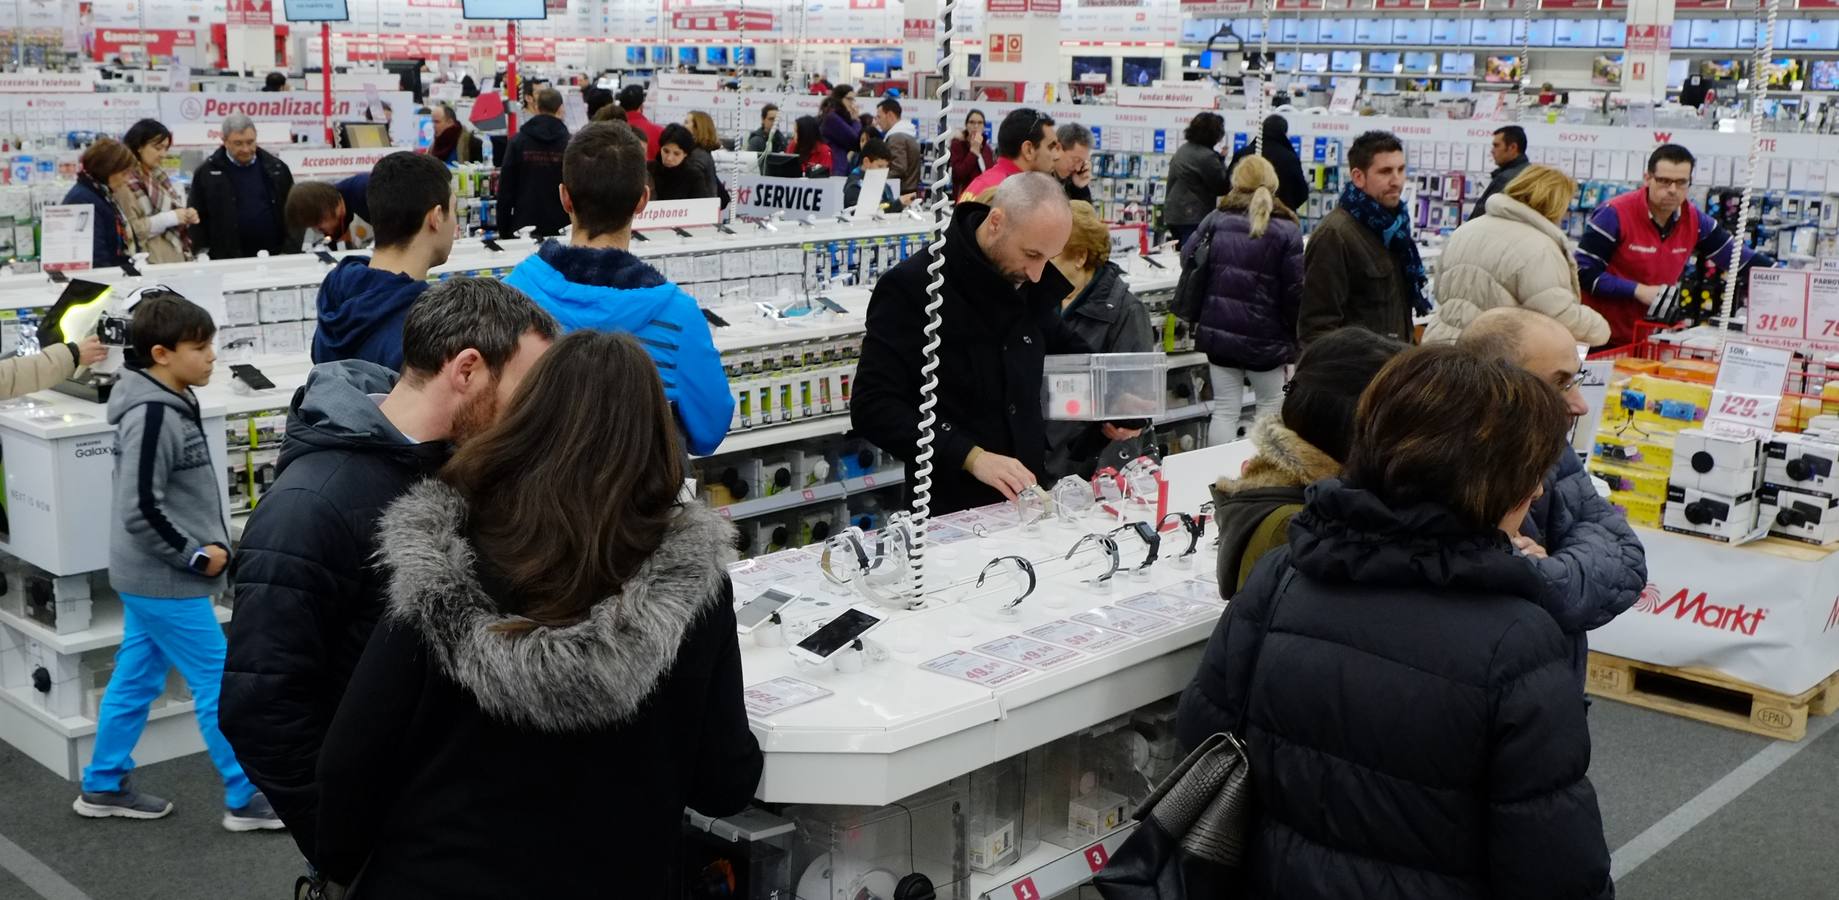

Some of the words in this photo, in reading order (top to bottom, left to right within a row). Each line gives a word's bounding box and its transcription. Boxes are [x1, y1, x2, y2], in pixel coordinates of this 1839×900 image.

[1138, 93, 1164, 102] Fundas
[1050, 110, 1082, 120] SAMSUNG
[1115, 113, 1147, 123] SAMSUNG
[1312, 121, 1350, 131] SAMSUNG
[1392, 126, 1432, 135] SAMSUNG
[1558, 132, 1599, 142] SONY
[302, 157, 353, 168] Accesorios
[754, 184, 823, 212] SERVICE
[1753, 273, 1780, 282] GIGASET
[1652, 587, 1766, 636] Markt
[1762, 711, 1785, 726] EPAL
[1092, 851, 1103, 865] 3
[1020, 885, 1032, 899] 1
